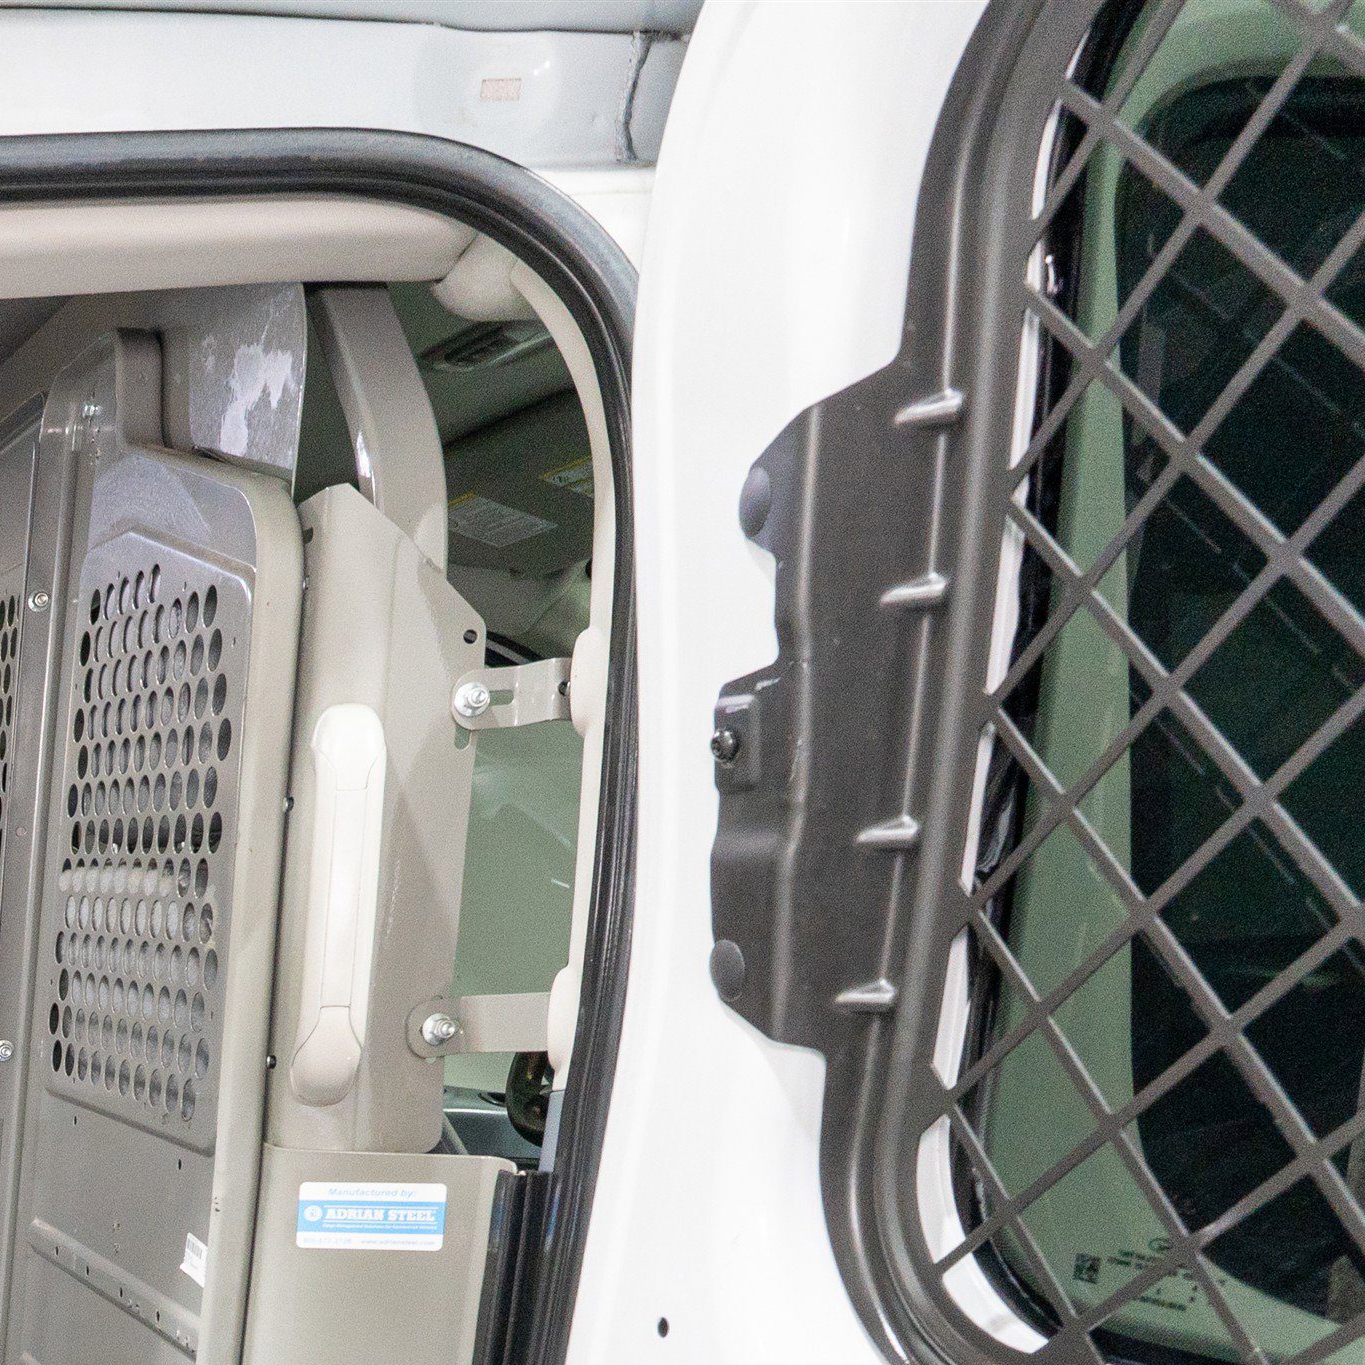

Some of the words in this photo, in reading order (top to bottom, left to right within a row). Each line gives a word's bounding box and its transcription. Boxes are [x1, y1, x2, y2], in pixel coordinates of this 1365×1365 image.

[328, 1187, 398, 1197] Manufactured
[325, 1208, 385, 1221] ADRIAN
[387, 1209, 436, 1222] STEEL
